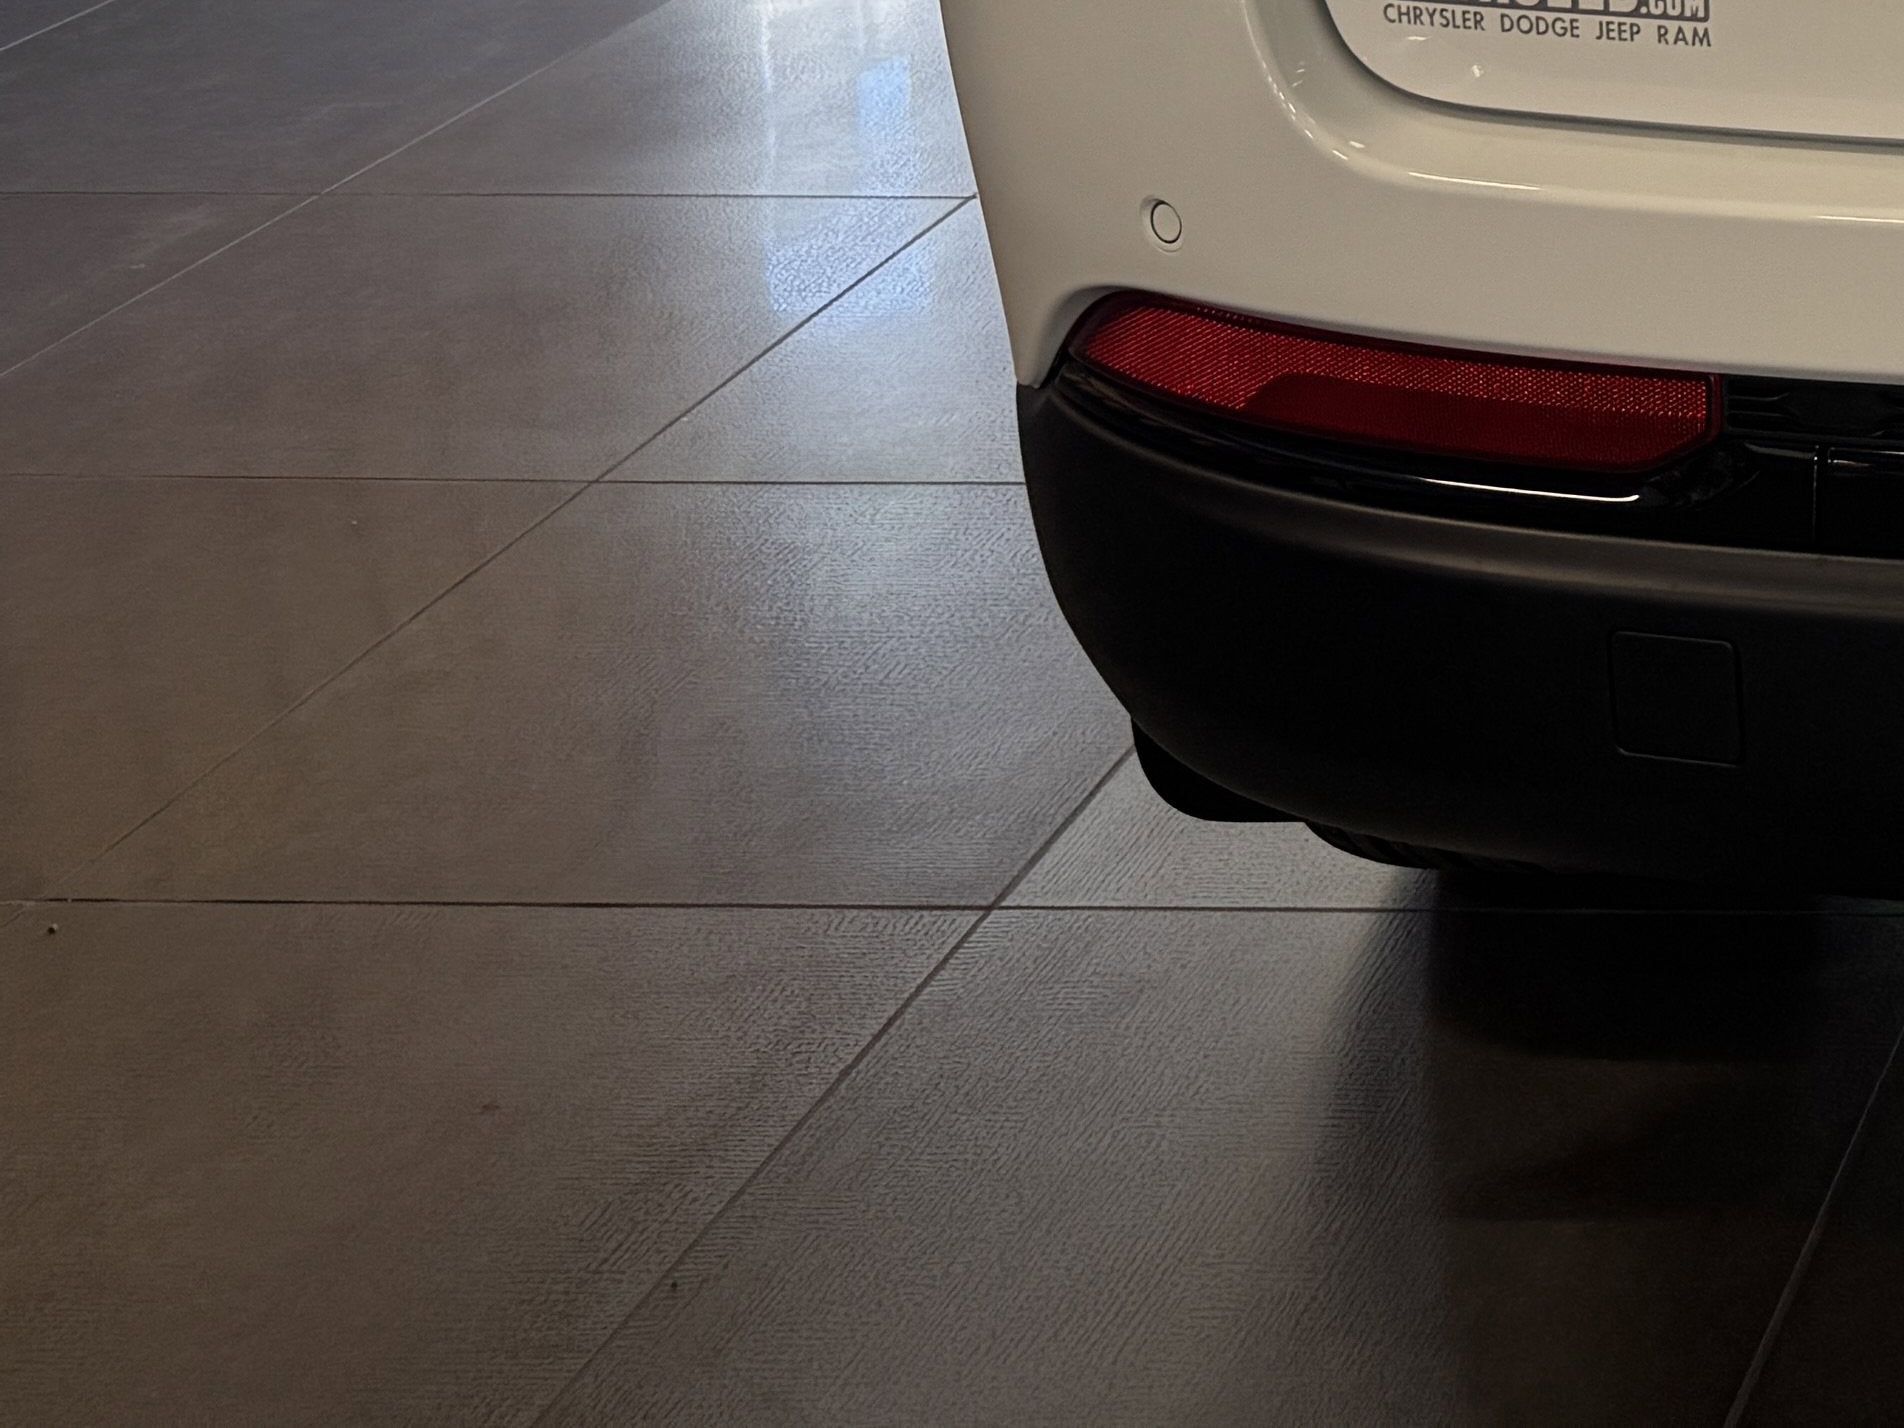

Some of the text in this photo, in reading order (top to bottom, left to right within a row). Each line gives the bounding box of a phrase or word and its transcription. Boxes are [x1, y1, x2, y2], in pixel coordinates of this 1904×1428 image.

[1383, 2, 1712, 48] CHRYSLER DODGE JEEP RAM
